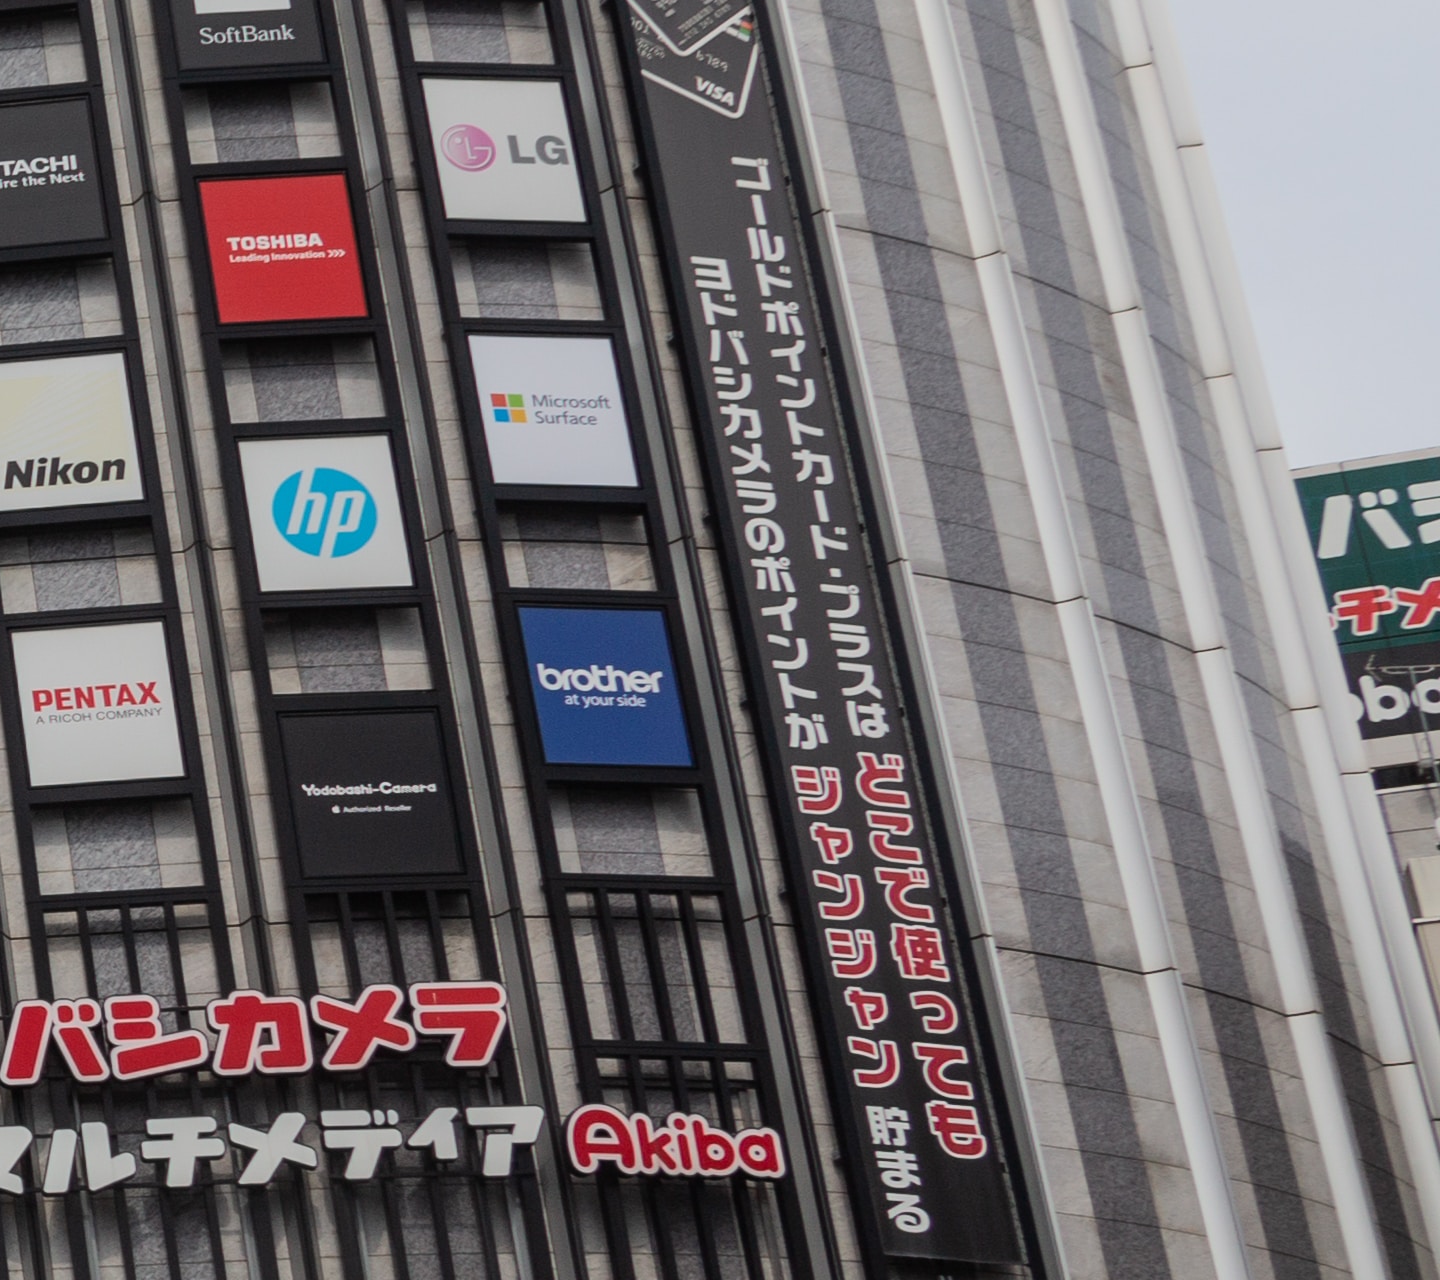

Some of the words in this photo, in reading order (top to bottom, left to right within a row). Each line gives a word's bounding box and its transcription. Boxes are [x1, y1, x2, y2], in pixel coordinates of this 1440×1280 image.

[198, 19, 297, 48] SoftBank
[694, 75, 736, 107] VISA
[506, 133, 571, 167] LG
[23, 173, 45, 190] the
[46, 170, 86, 188] Next
[226, 232, 325, 254] TOSHIBA
[228, 250, 269, 266] Leading
[270, 246, 327, 263] Innovation
[530, 392, 613, 414] Microsoft
[533, 410, 599, 428] Surface
[3, 453, 128, 490] Nikon
[535, 661, 663, 698] brother
[31, 680, 162, 715] PENTAX
[564, 693, 578, 707] at
[579, 694, 612, 711] your
[614, 691, 647, 708] side
[35, 714, 45, 726] A
[47, 710, 92, 725] RICOH
[94, 704, 165, 722] COMPANY
[300, 781, 438, 799] Yodobashi-Camera
[341, 803, 382, 815] Authorized
[382, 802, 414, 814] Reseller
[565, 1104, 786, 1181] Akiba
